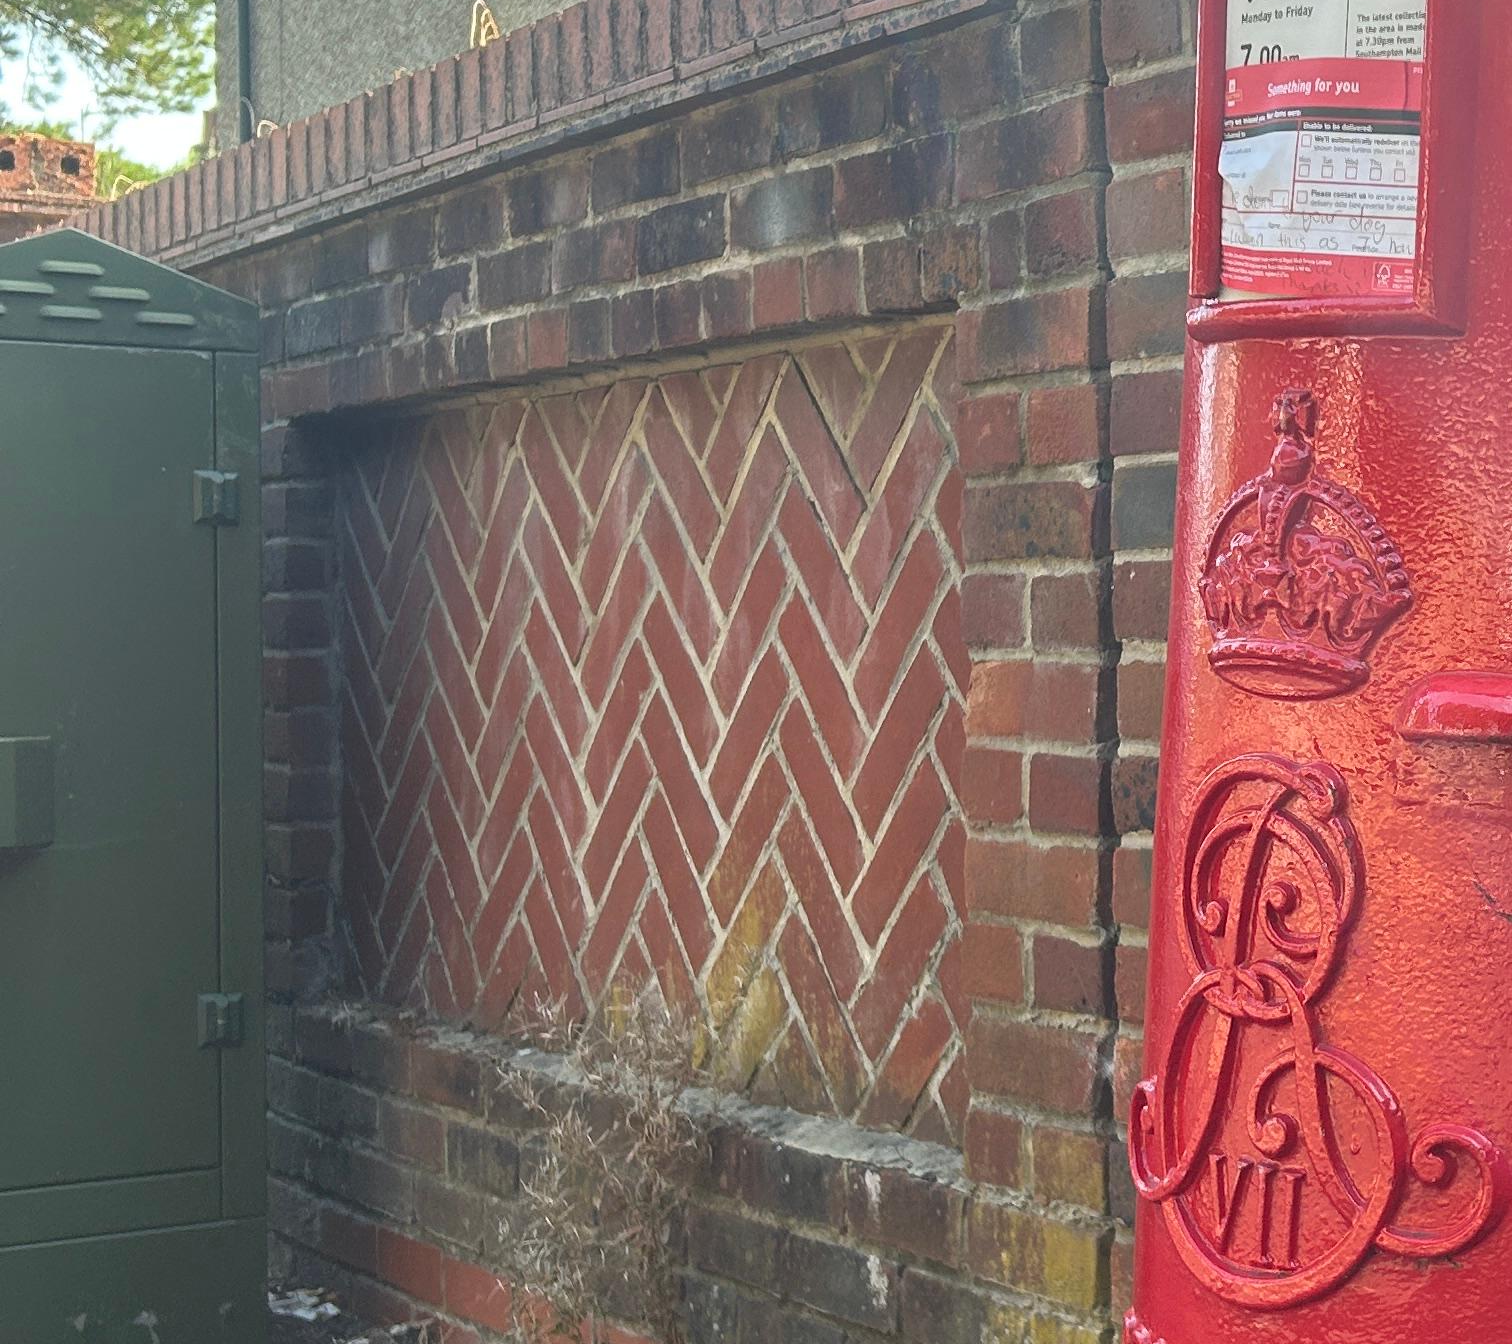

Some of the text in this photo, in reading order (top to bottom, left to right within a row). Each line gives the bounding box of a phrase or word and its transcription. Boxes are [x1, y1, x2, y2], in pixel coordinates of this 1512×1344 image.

[1241, 5, 1314, 24] Monday to Friday
[1268, 77, 1360, 97] Something for you
[1209, 1153, 1307, 1272] VII
